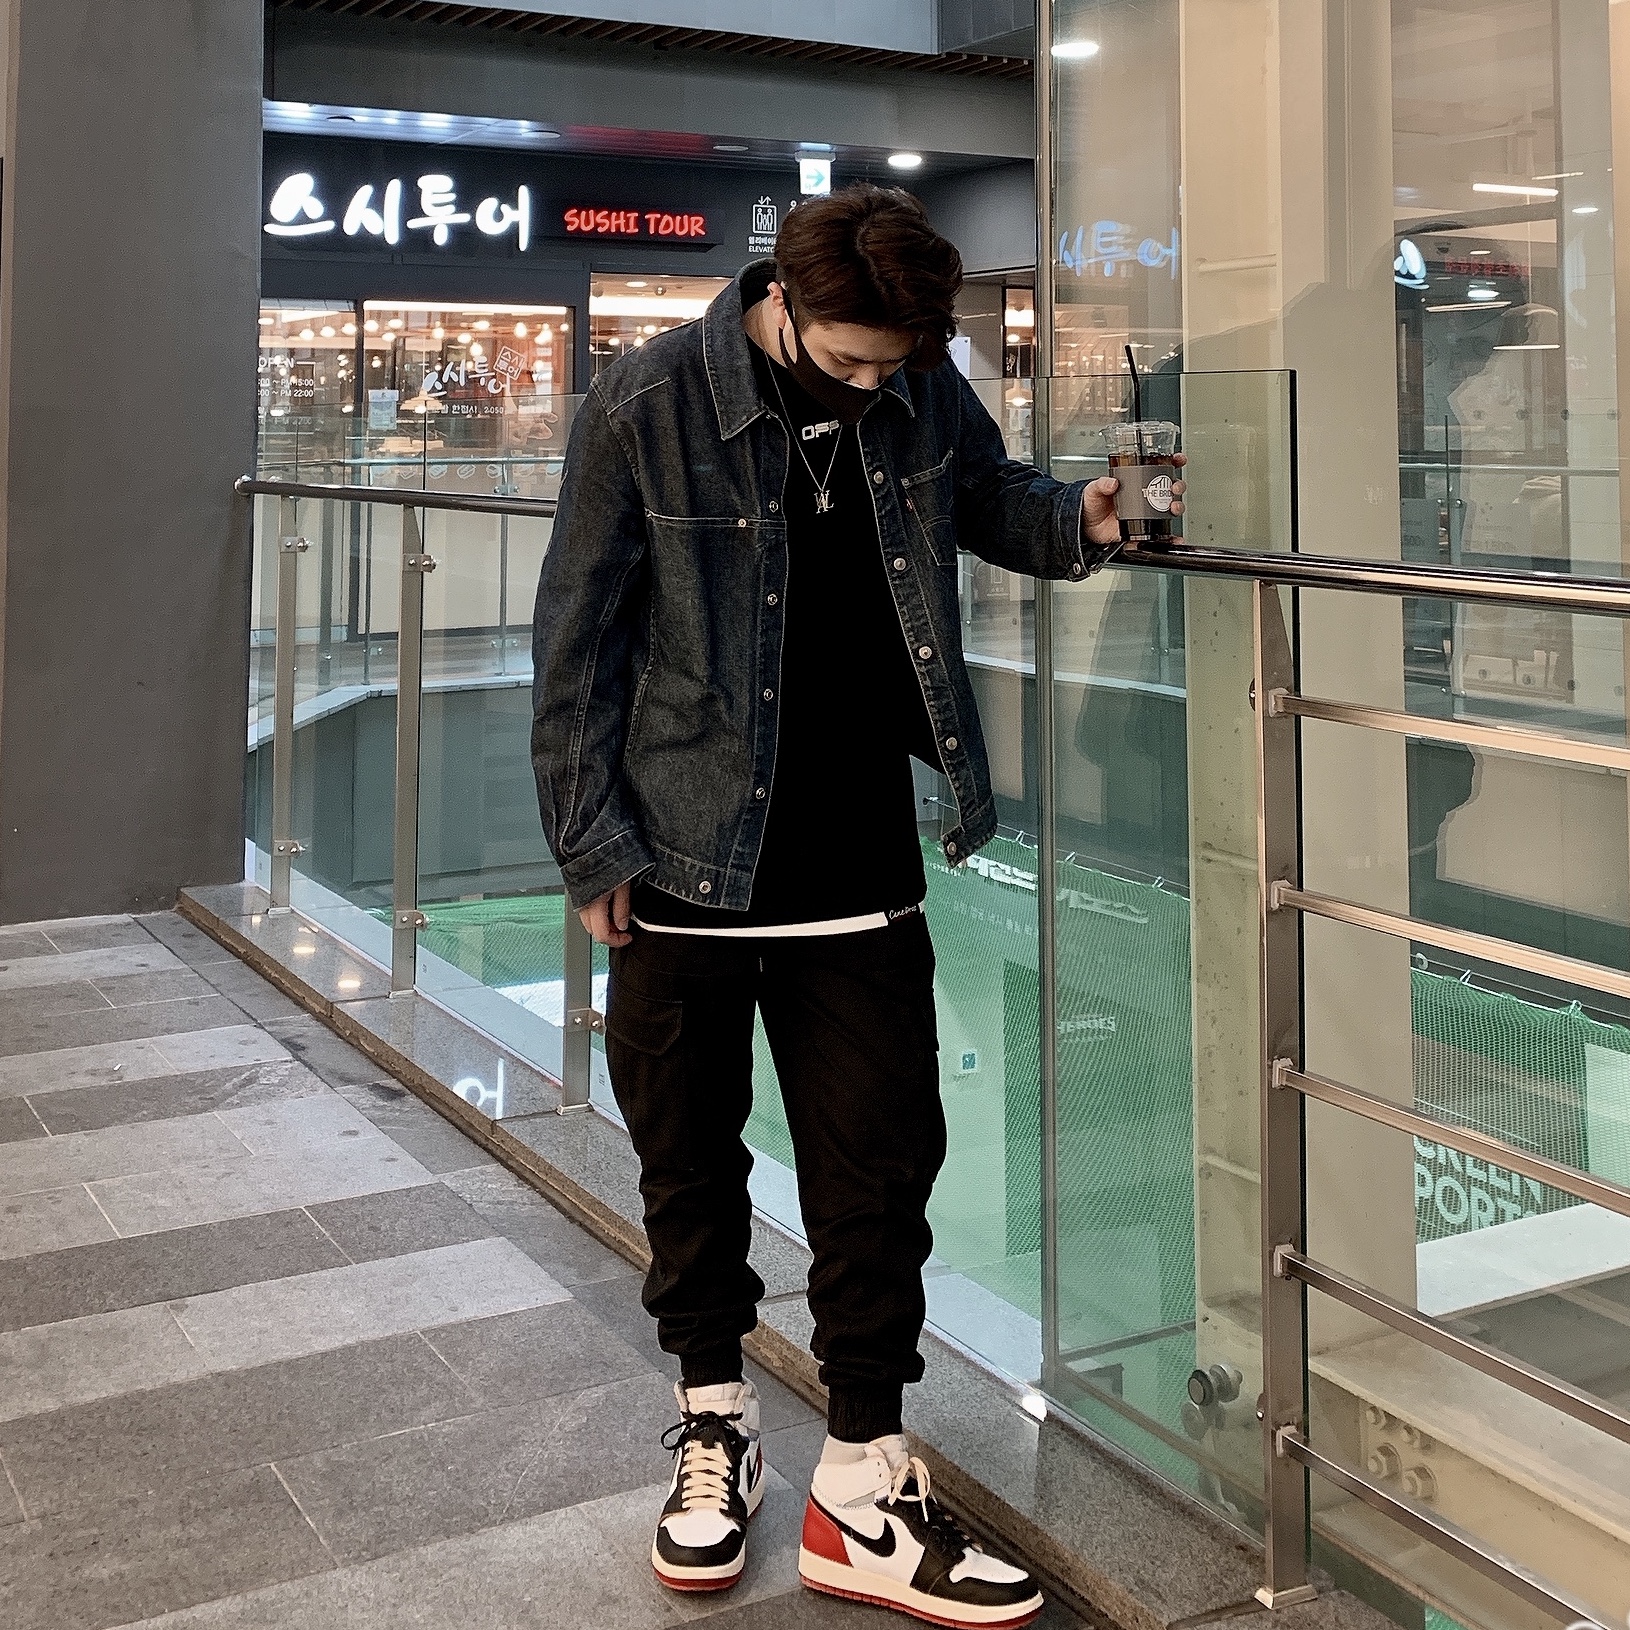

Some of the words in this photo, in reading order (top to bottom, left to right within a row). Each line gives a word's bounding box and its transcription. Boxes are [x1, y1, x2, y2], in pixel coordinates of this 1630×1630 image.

[263, 172, 531, 252] 스시투어
[564, 208, 639, 234] SUSHI
[644, 213, 706, 237] TOUR
[748, 245, 775, 253] ELEVATO
[1414, 1161, 1537, 1230] PORT
